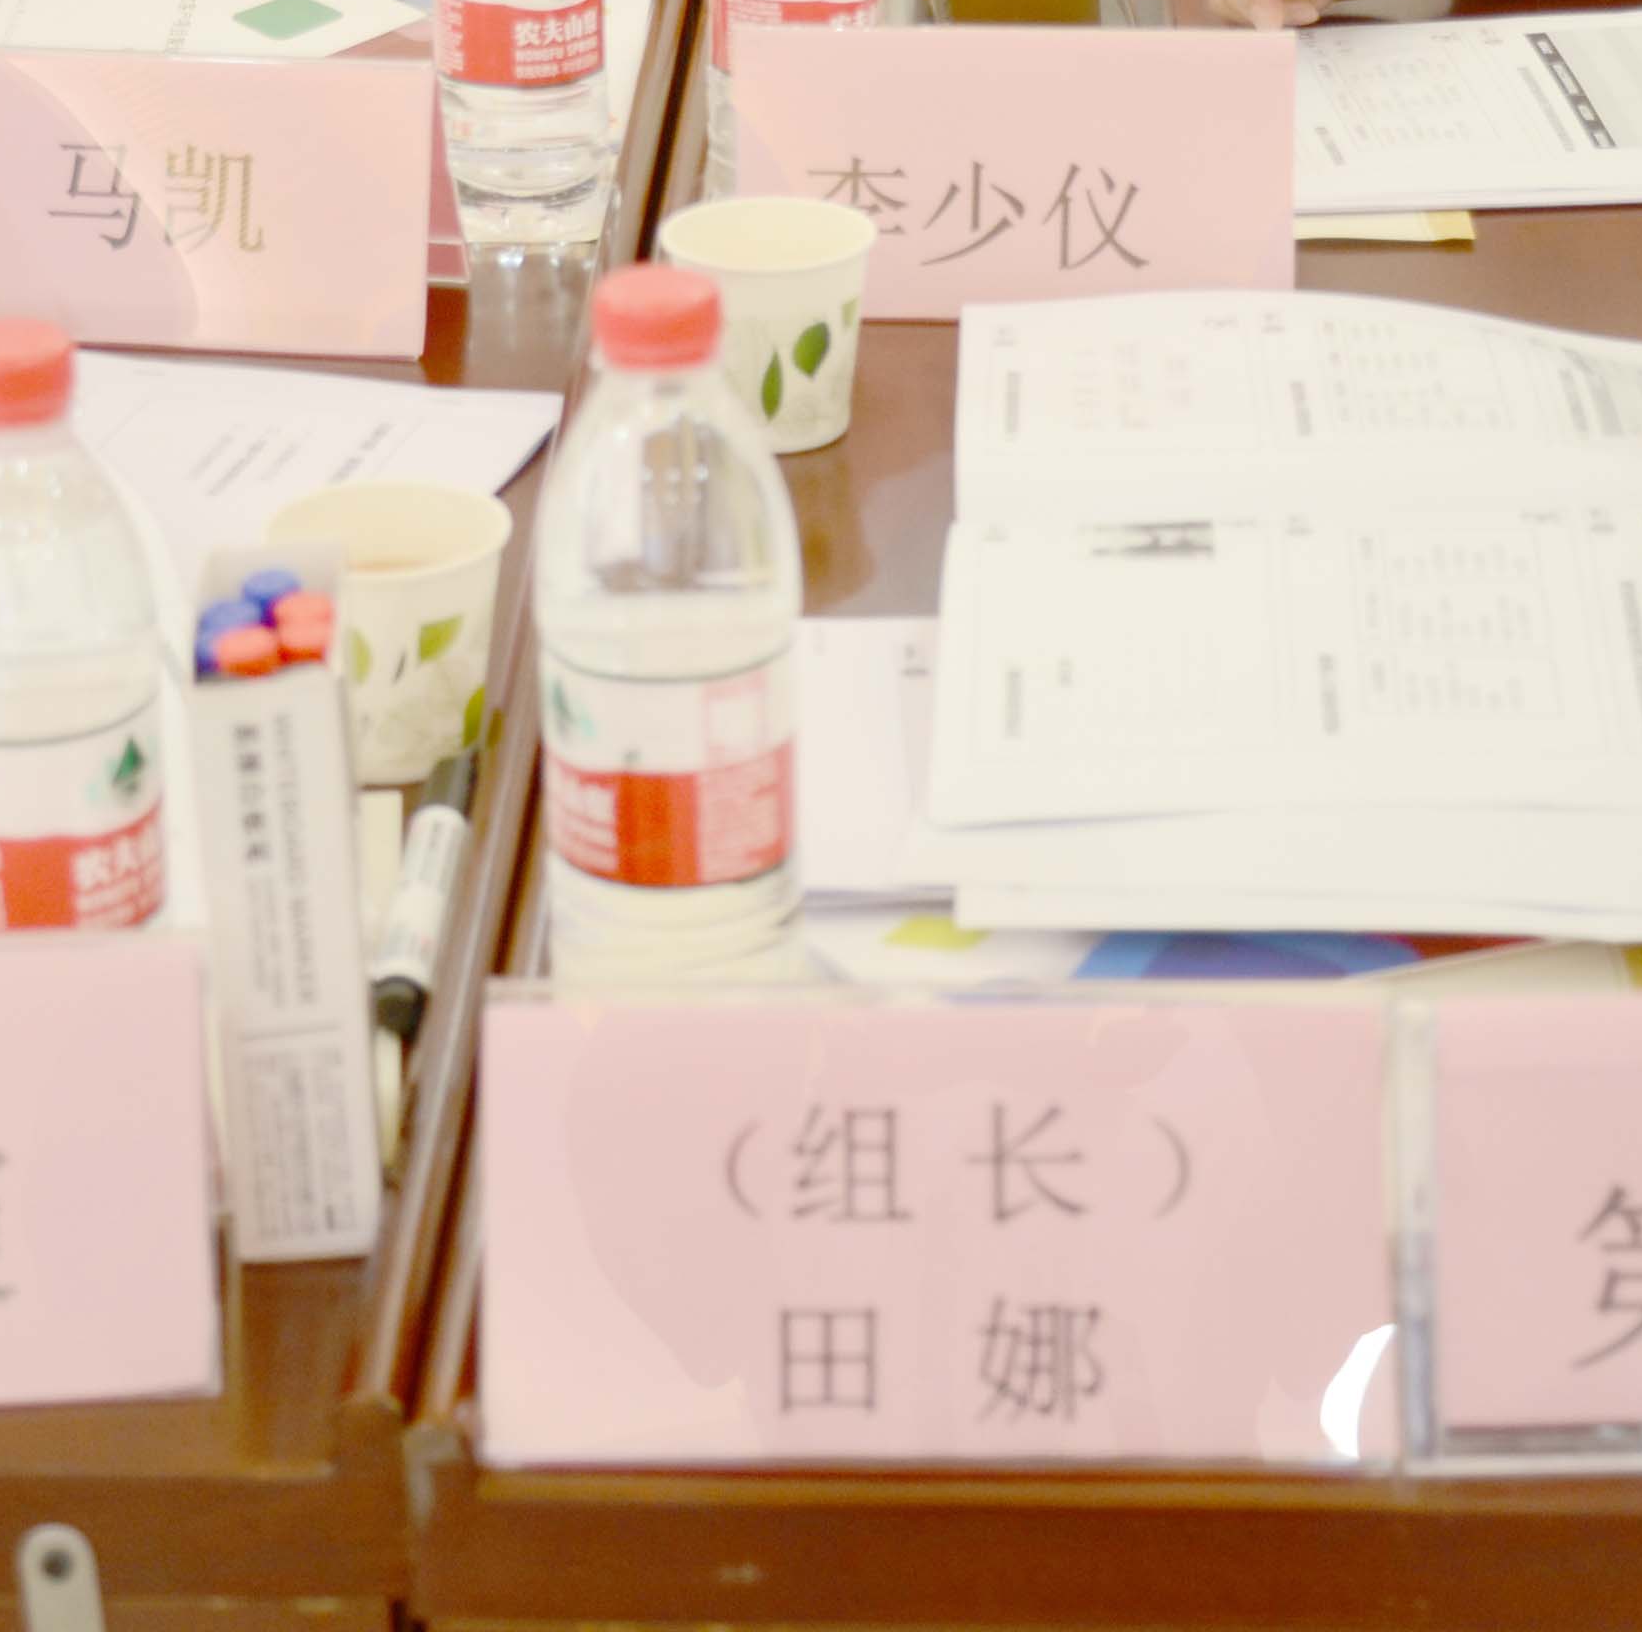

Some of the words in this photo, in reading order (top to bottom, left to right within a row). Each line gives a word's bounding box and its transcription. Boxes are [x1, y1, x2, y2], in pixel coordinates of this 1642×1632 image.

[47, 142, 266, 252] 马凯
[807, 155, 1150, 272] 李少仪
